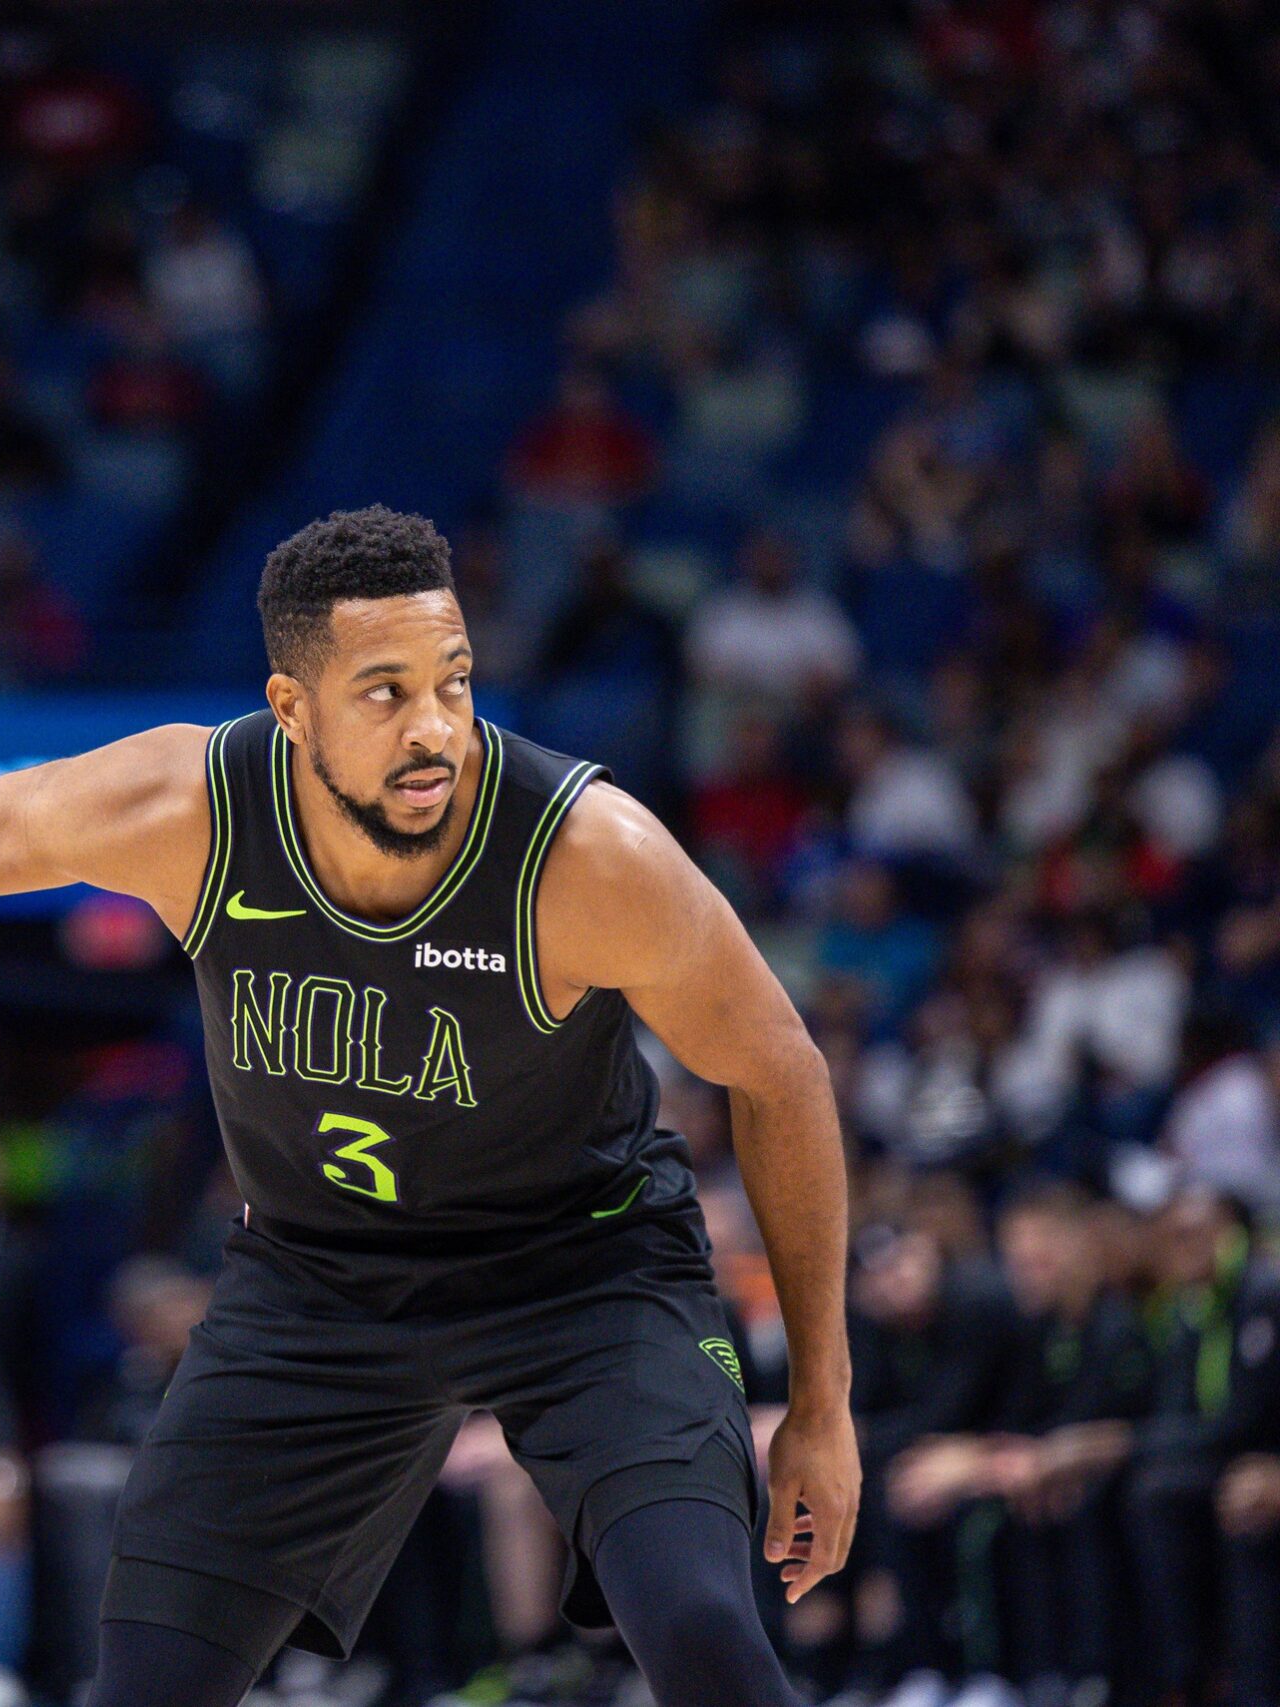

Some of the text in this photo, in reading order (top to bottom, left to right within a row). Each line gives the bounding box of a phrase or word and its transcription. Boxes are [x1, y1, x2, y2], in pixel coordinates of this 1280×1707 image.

[414, 942, 507, 973] ibotta
[230, 968, 478, 1107] NOLA
[314, 1110, 400, 1202] 3
